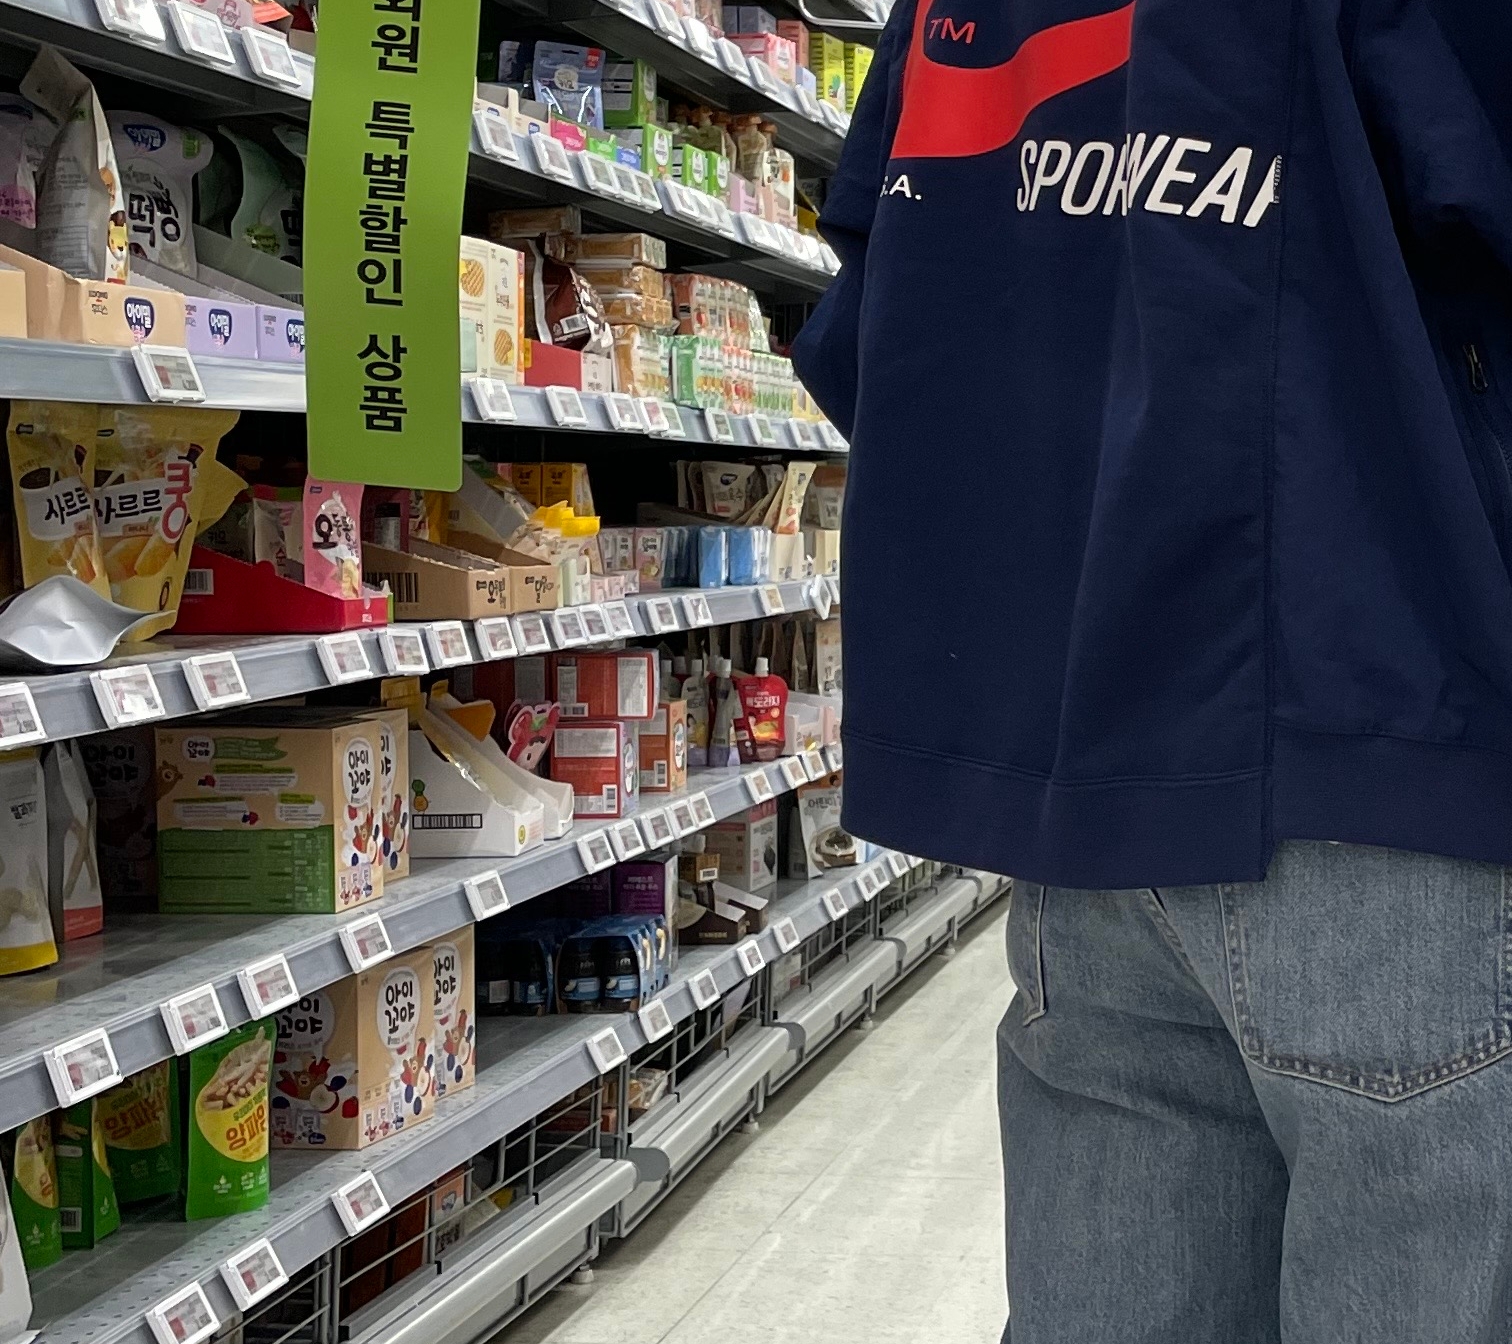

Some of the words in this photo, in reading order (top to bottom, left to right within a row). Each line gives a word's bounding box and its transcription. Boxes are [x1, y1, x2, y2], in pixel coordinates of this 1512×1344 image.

[929, 17, 976, 44] TM
[357, 100, 415, 307] 특별할인
[126, 303, 153, 329] 아이밀
[357, 333, 408, 433] 상품
[384, 974, 415, 1003] 아이
